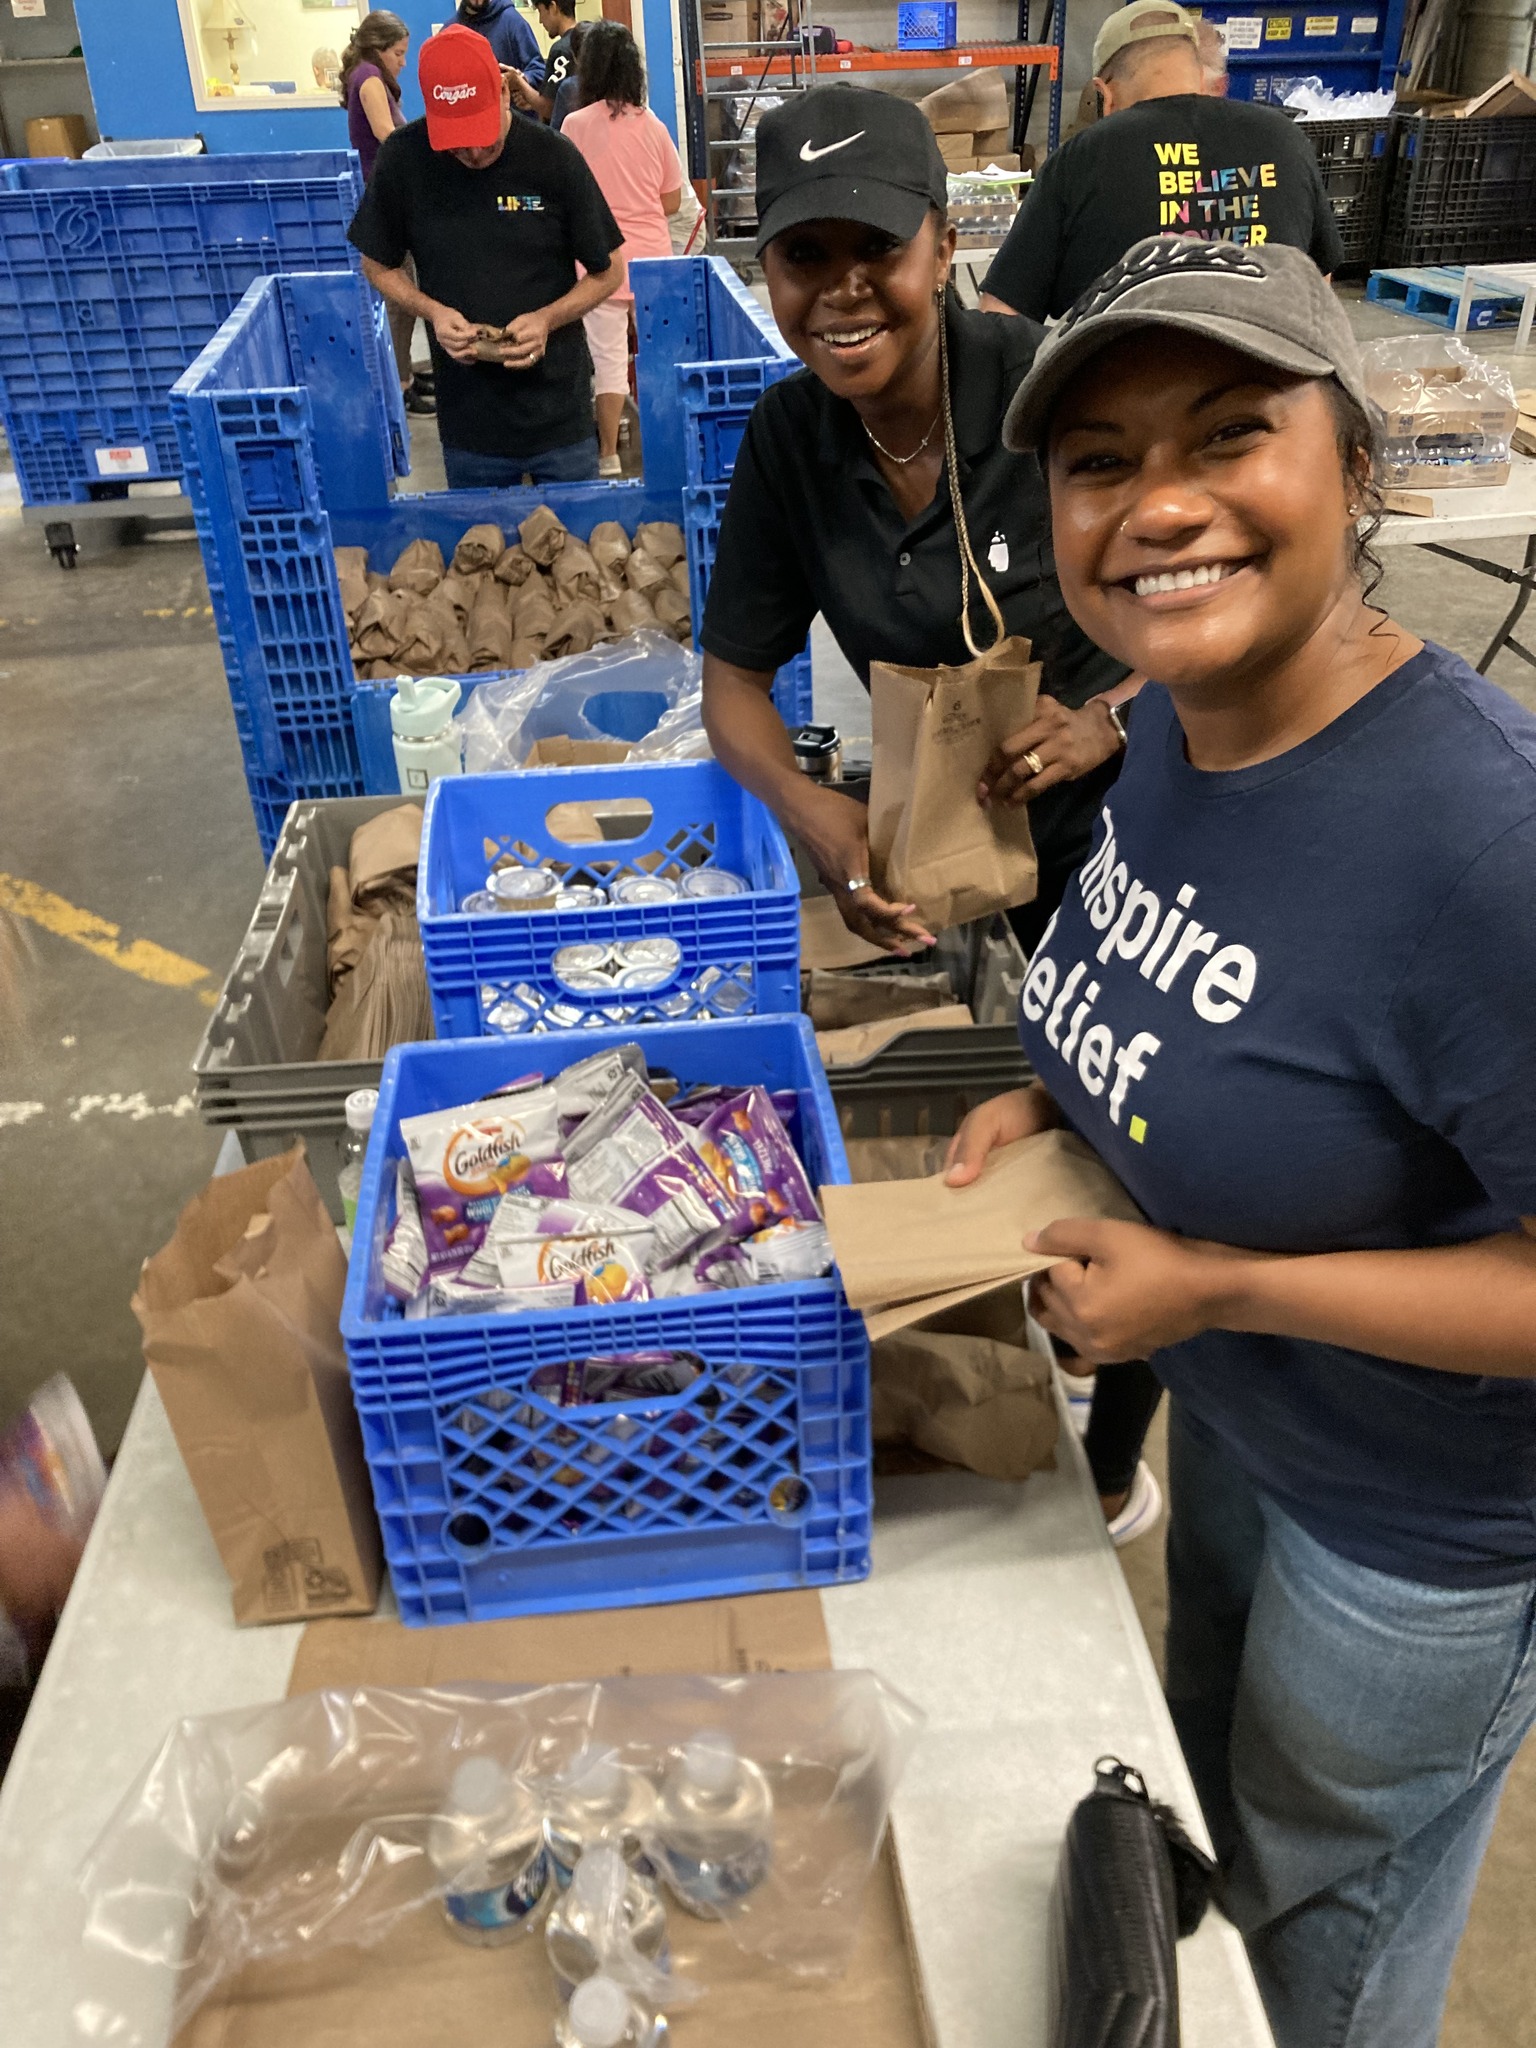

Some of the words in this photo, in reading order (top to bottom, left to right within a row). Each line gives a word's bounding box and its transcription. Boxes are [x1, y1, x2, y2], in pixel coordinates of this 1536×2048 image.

[433, 84, 476, 105] Cougars
[1154, 143, 1199, 165] WE
[1159, 163, 1277, 194] BELIEVE
[1160, 200, 1190, 225] IN
[1197, 194, 1260, 222] THE
[454, 1130, 521, 1176] Goldfish
